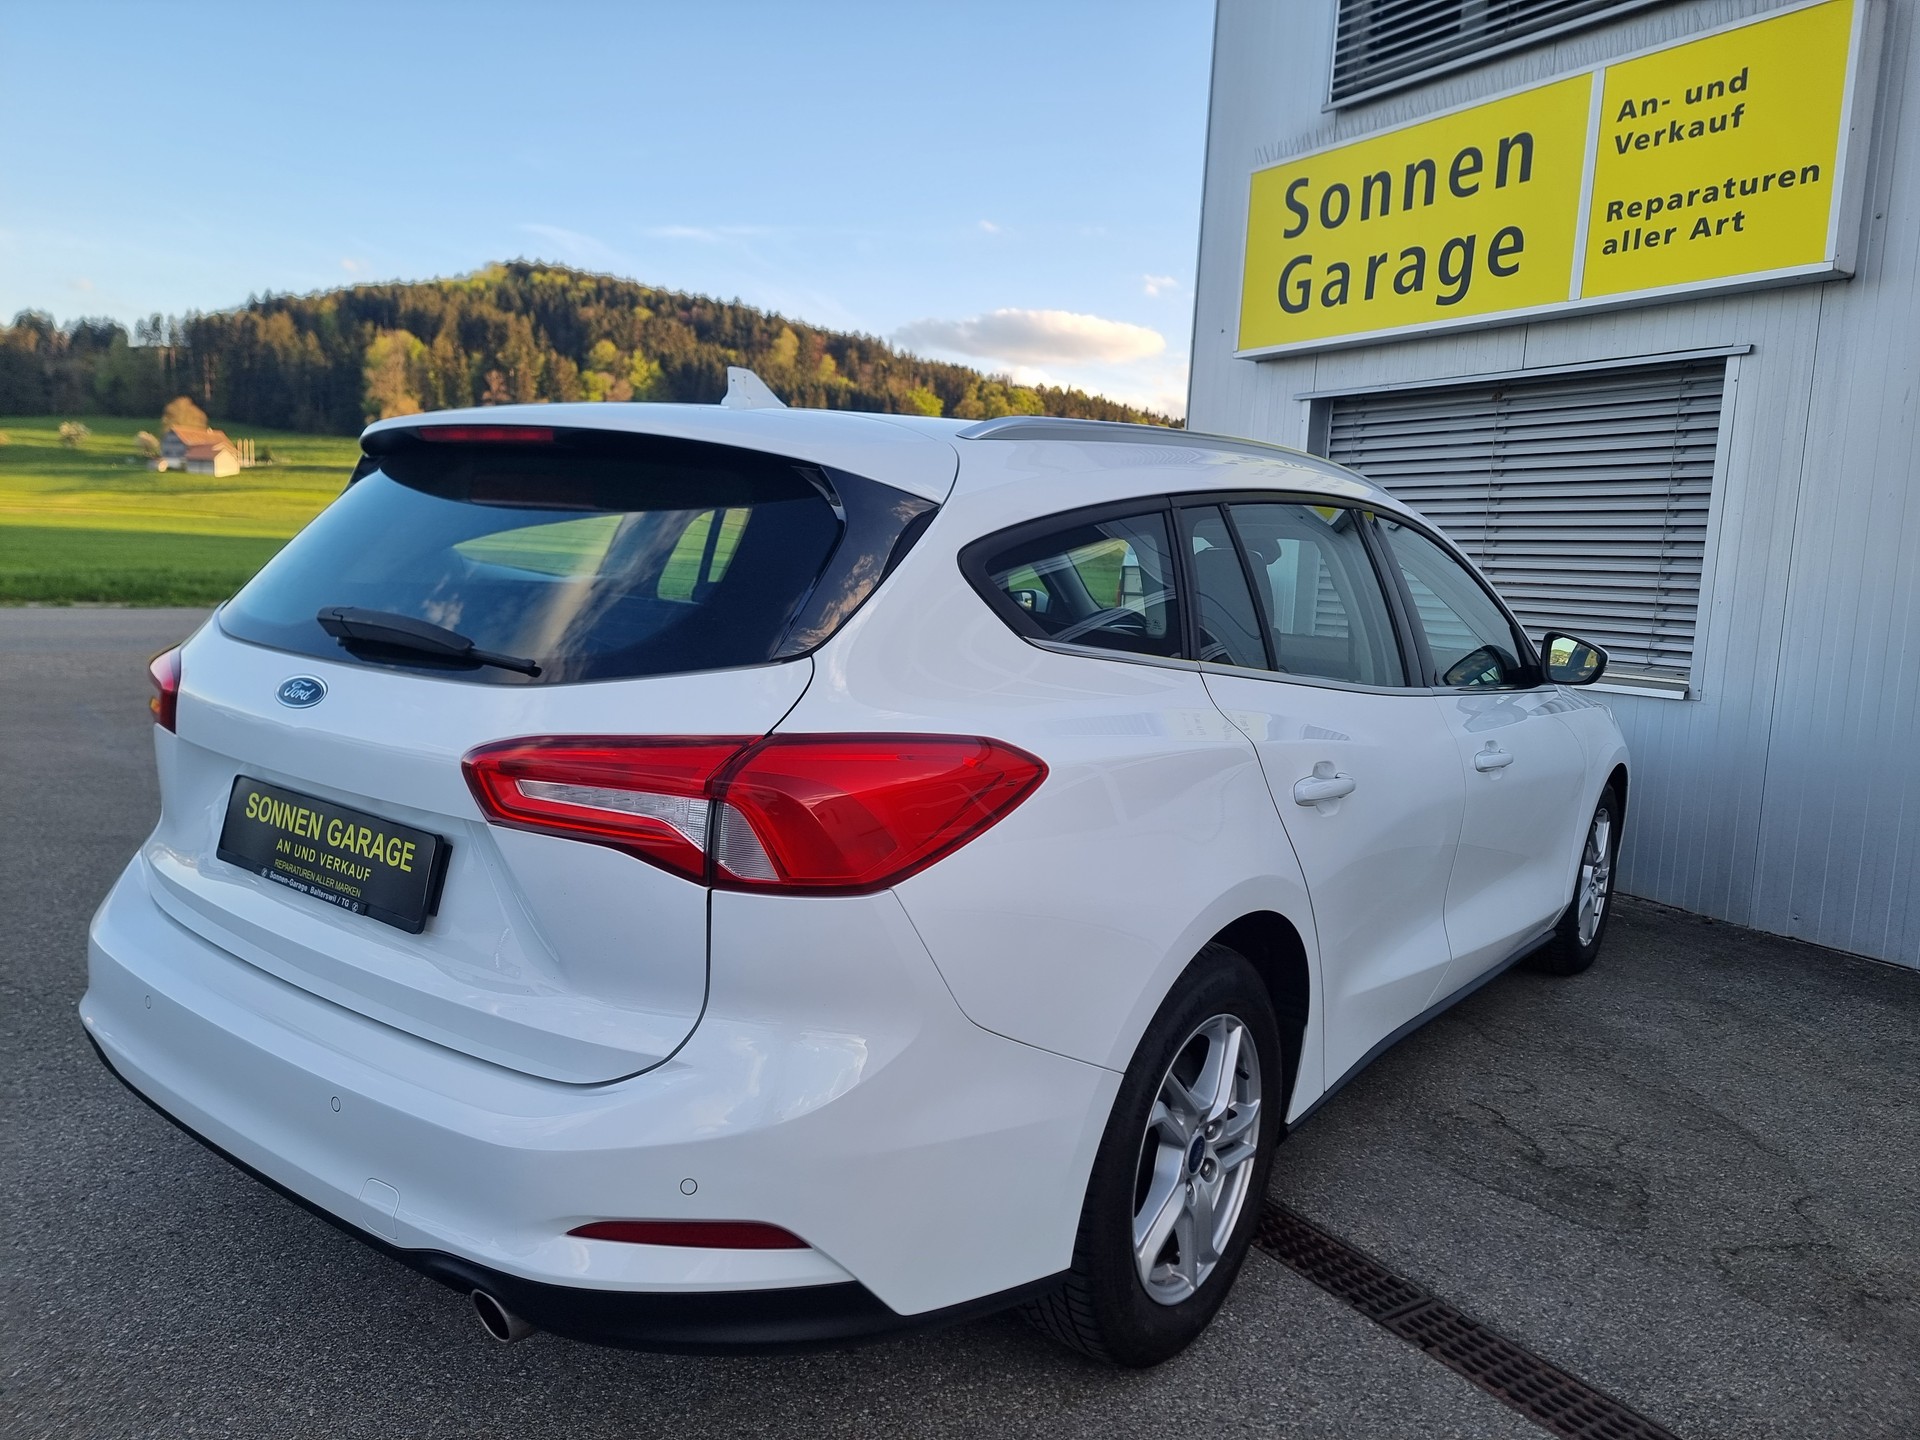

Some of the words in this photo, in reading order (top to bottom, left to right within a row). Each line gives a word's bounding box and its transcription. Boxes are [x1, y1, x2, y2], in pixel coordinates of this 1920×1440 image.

[1616, 98, 1671, 123] An-
[1685, 67, 1749, 103] und
[1614, 104, 1746, 156] Verkauf
[1283, 130, 1535, 239] Sonnen
[1605, 163, 1821, 224] Reparaturen
[1601, 226, 1677, 256] aller
[1689, 210, 1745, 241] Art
[1277, 224, 1525, 315] Garage
[284, 680, 316, 701] Ford
[246, 792, 323, 841] SONNEN
[327, 818, 416, 872] GARAGE
[275, 859, 315, 881] REPARATUREN
[315, 873, 335, 888] ALLER
[334, 880, 362, 898] MARKEN
[276, 838, 290, 854] AN
[294, 845, 316, 863] UND
[320, 852, 372, 882] VERKAUF
[341, 897, 350, 908] TG
